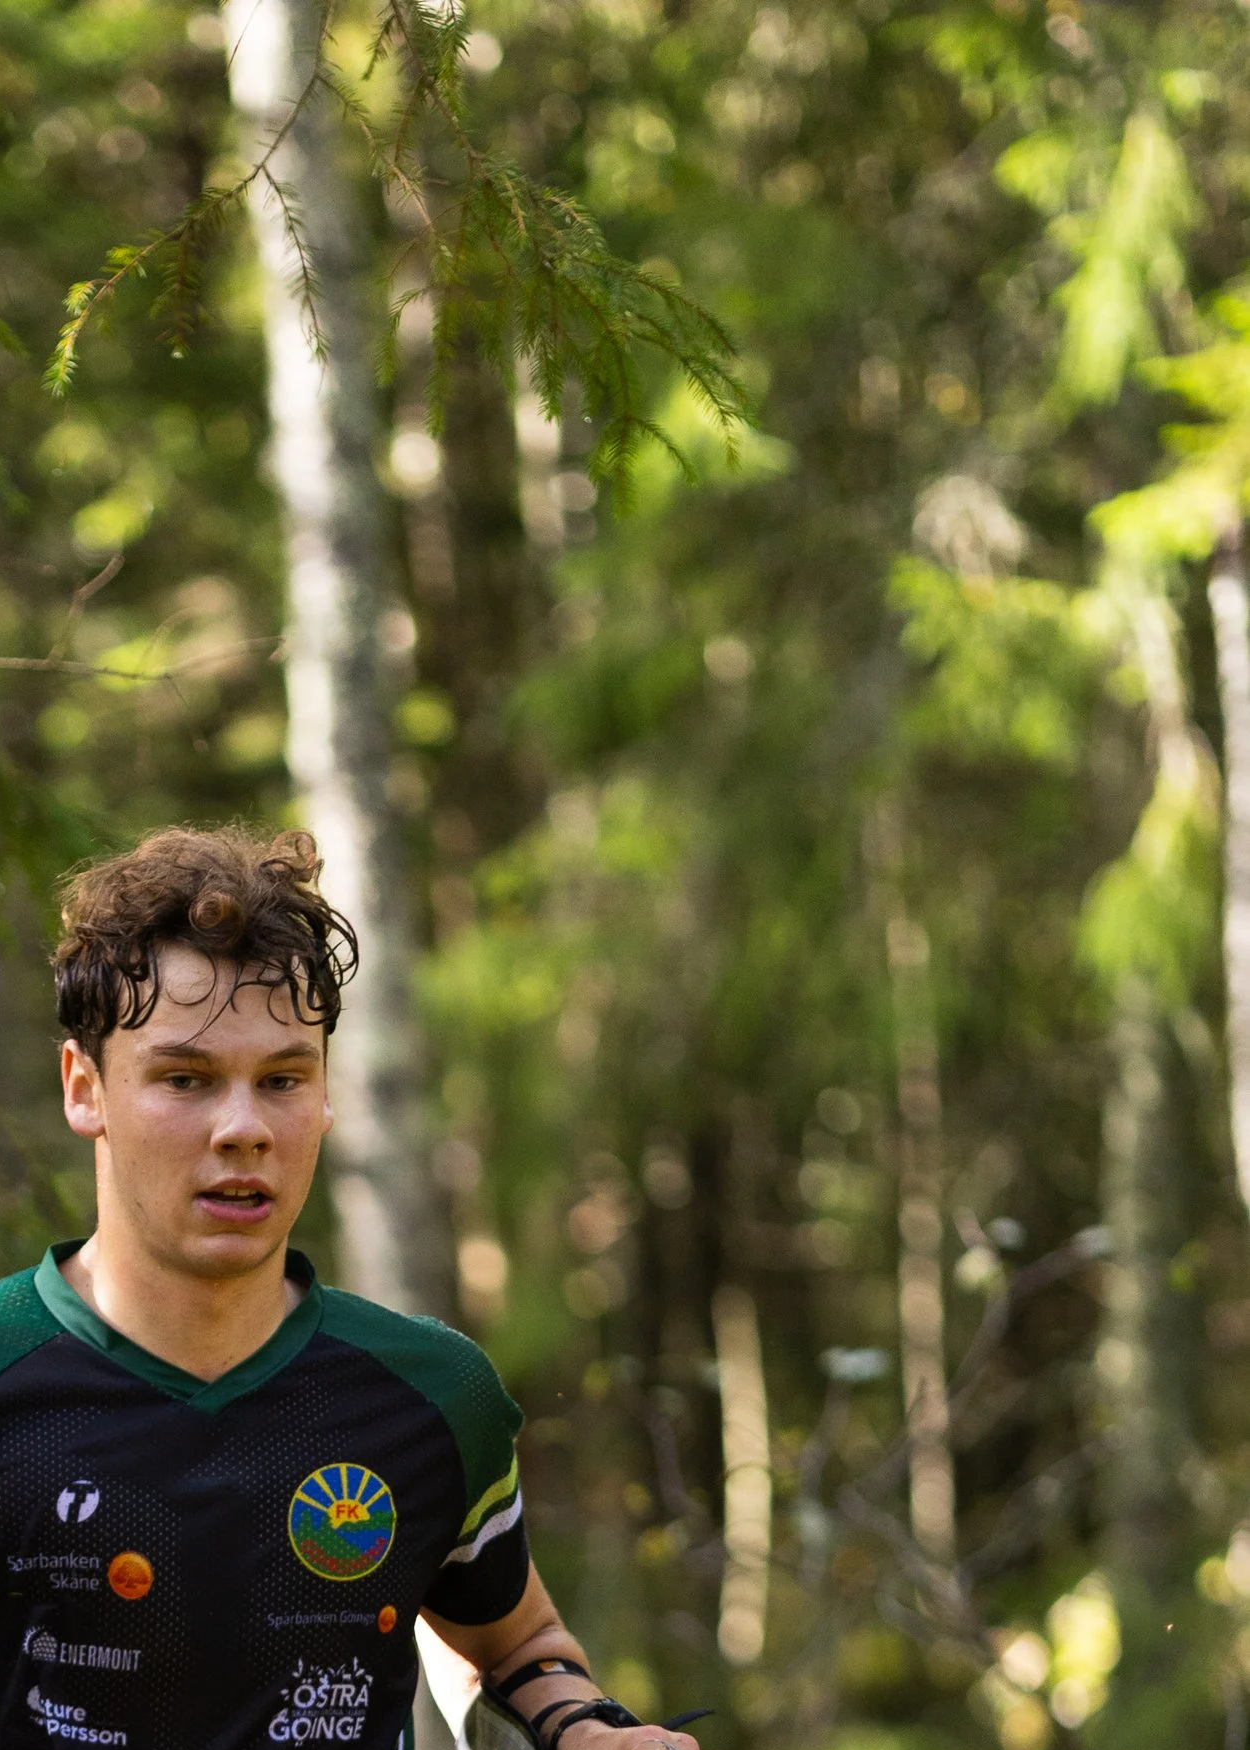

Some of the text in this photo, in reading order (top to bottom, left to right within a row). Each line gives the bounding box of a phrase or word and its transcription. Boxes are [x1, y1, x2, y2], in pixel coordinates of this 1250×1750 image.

[336, 1504, 359, 1519] FK
[59, 1642, 141, 1672] ENERMONT
[293, 1678, 369, 1709] ÖSTRA
[46, 1719, 127, 1746] Persson
